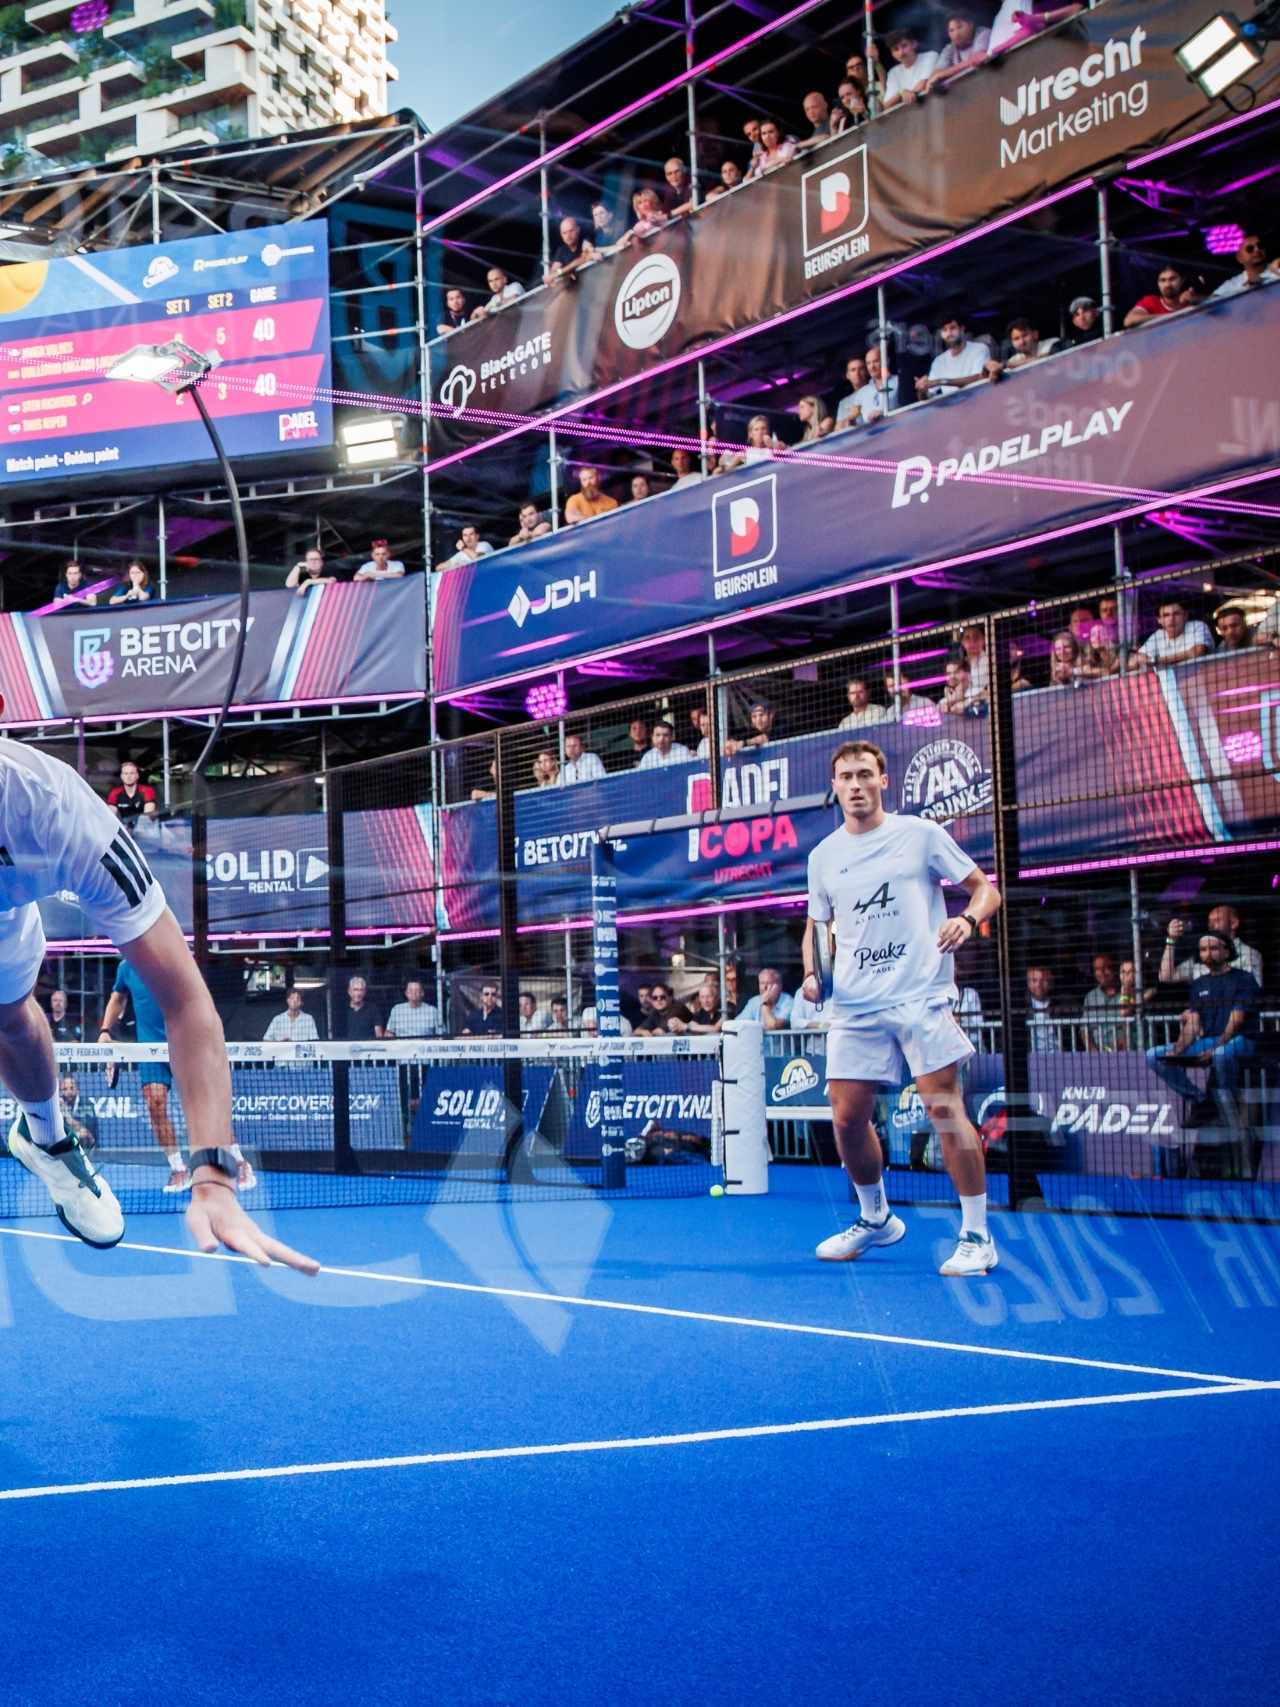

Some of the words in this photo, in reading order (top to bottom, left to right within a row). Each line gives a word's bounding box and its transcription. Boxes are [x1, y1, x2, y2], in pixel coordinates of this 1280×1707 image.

[1000, 25, 1148, 126] Utrecht
[1000, 80, 1148, 169] Marketing
[804, 234, 870, 280] BEURSPLEIN
[623, 284, 671, 320] Lipton
[253, 318, 275, 341] 40
[480, 331, 551, 380] BlackGATE
[480, 350, 552, 395] TELECOM
[254, 372, 276, 396] 40
[937, 400, 1134, 486] PADELPLAY
[530, 569, 597, 617] JDH
[715, 565, 778, 600] BEURSPLEIN
[119, 616, 255, 657] BETCITY
[120, 654, 198, 678] ARENA
[700, 814, 798, 860] COPA
[248, 880, 295, 893] RENTAL
[853, 941, 907, 970] Peakz
[433, 1089, 500, 1117] SOLID
[624, 1094, 714, 1120] ETCITY.NL
[1061, 1086, 1106, 1101] KNLTB
[1051, 1101, 1176, 1135] PADEL
